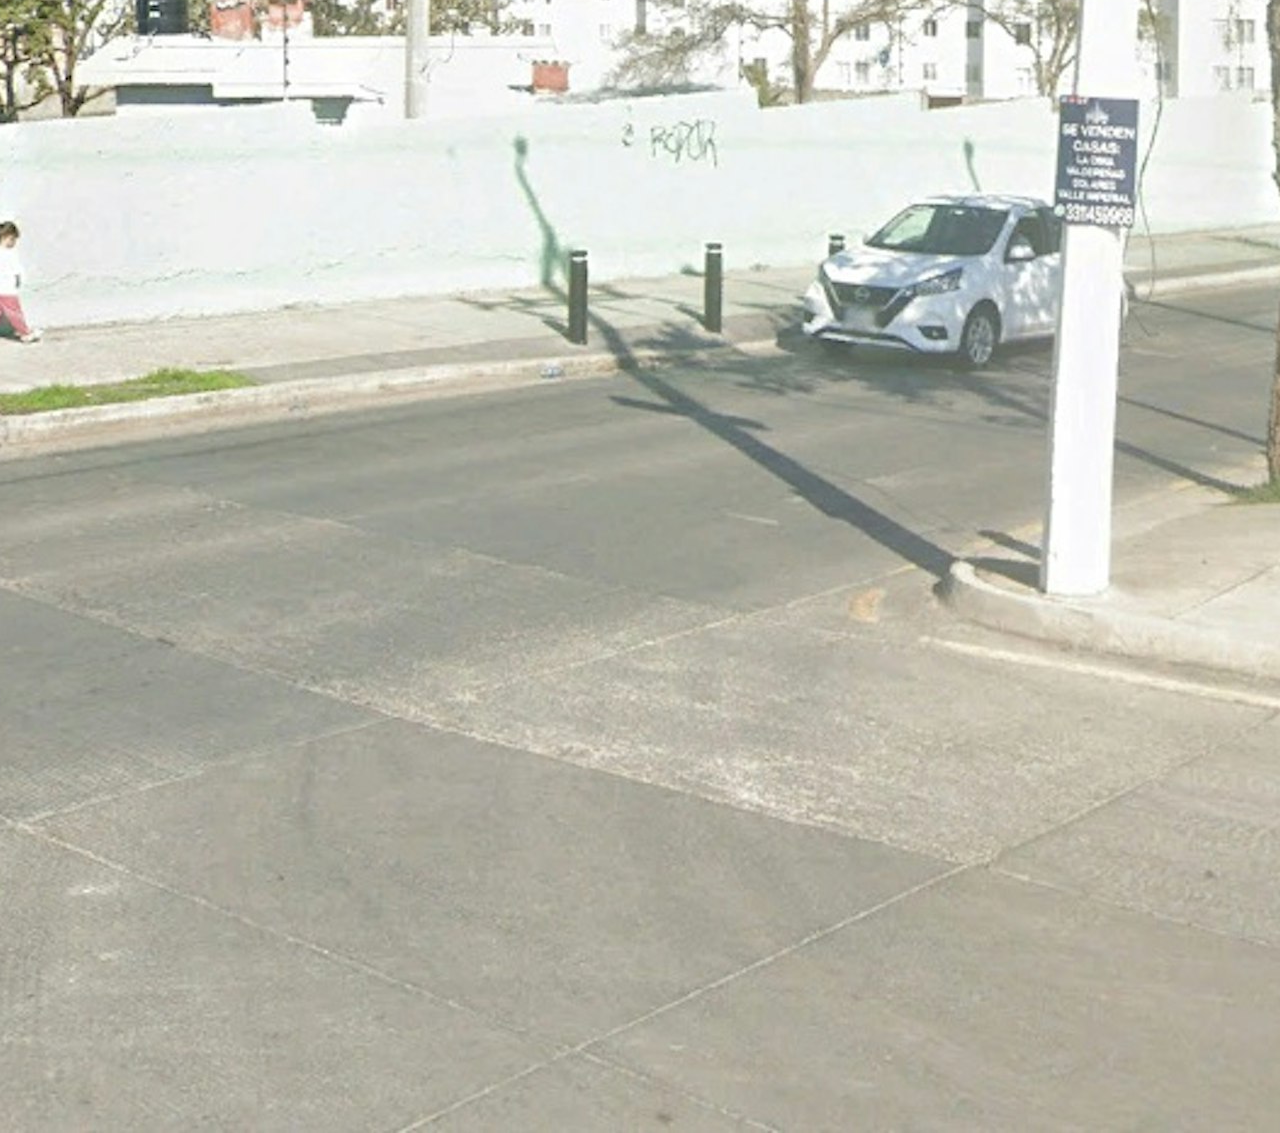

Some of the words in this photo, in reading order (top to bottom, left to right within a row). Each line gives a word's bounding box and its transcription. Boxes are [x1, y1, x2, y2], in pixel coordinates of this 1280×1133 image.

[1061, 123, 1078, 138] SE
[1081, 124, 1135, 141] VENDEN
[1057, 189, 1085, 200] VALLE
[1086, 191, 1131, 204] IMPERIAL
